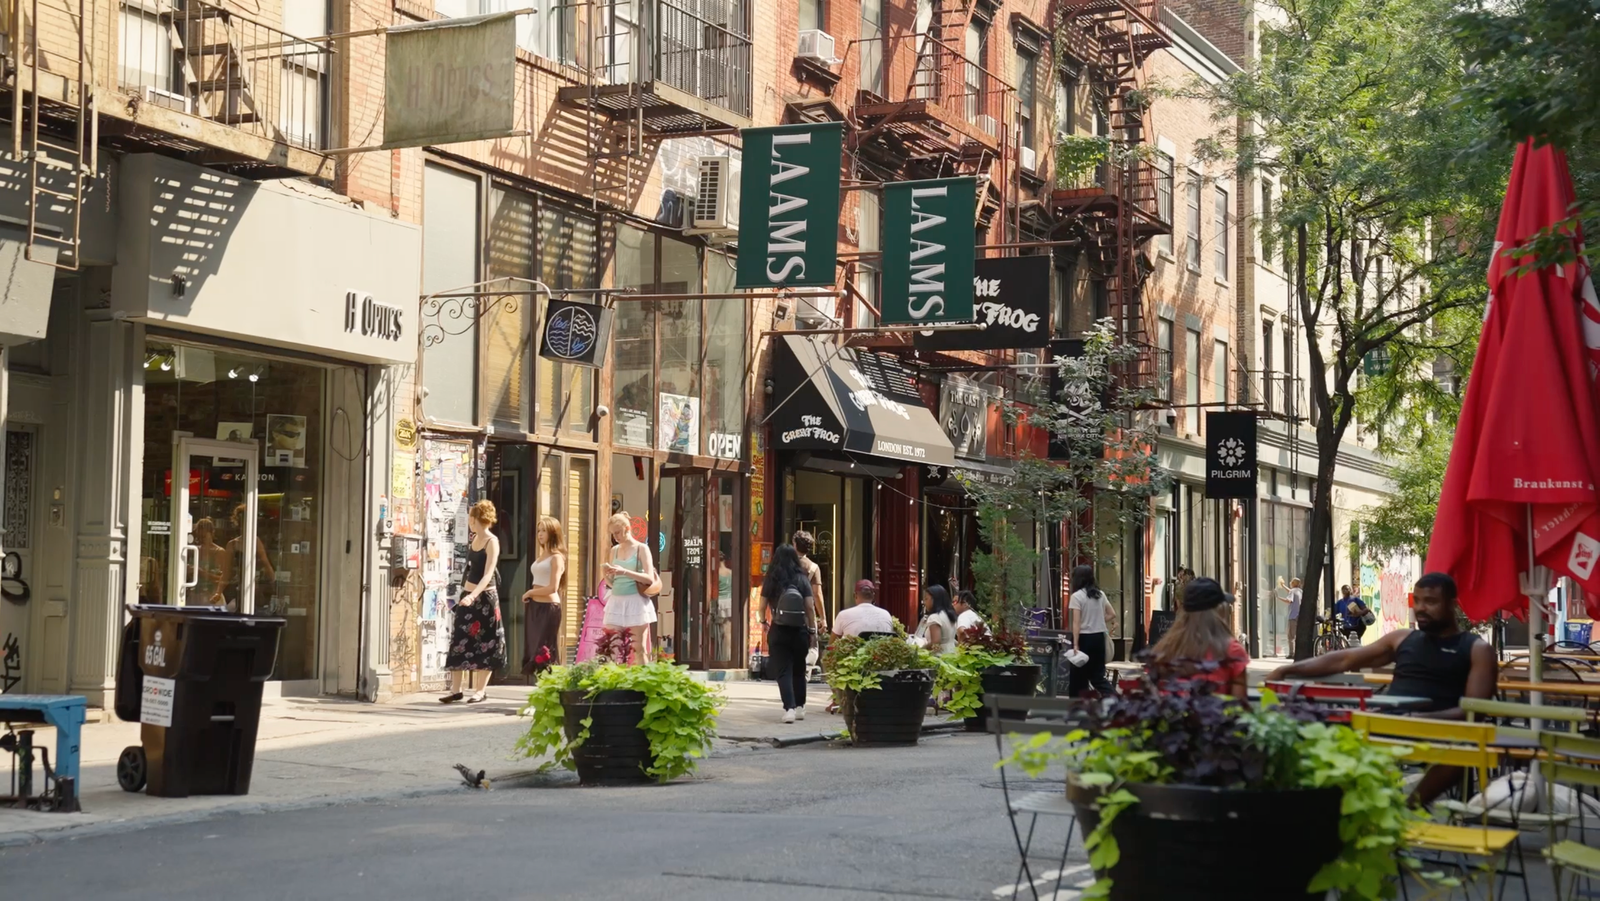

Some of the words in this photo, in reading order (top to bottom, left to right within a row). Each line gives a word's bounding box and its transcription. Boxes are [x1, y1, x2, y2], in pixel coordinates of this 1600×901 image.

[766, 132, 812, 284] LAAMS
[907, 185, 949, 320] LAAMS
[344, 291, 357, 334] H
[982, 302, 1041, 333] FROG
[950, 390, 963, 404] THE
[964, 395, 980, 408] CAST
[801, 415, 822, 427] THE
[812, 426, 840, 443] FROG
[709, 433, 741, 459] OPEN
[877, 440, 903, 454] LONDON
[902, 444, 914, 456] EST.
[914, 447, 926, 458] 1972
[1211, 470, 1251, 478] PILGRIM
[1513, 477, 1583, 489] Braukunst
[145, 645, 153, 665] 65
[153, 646, 166, 668] GAL
